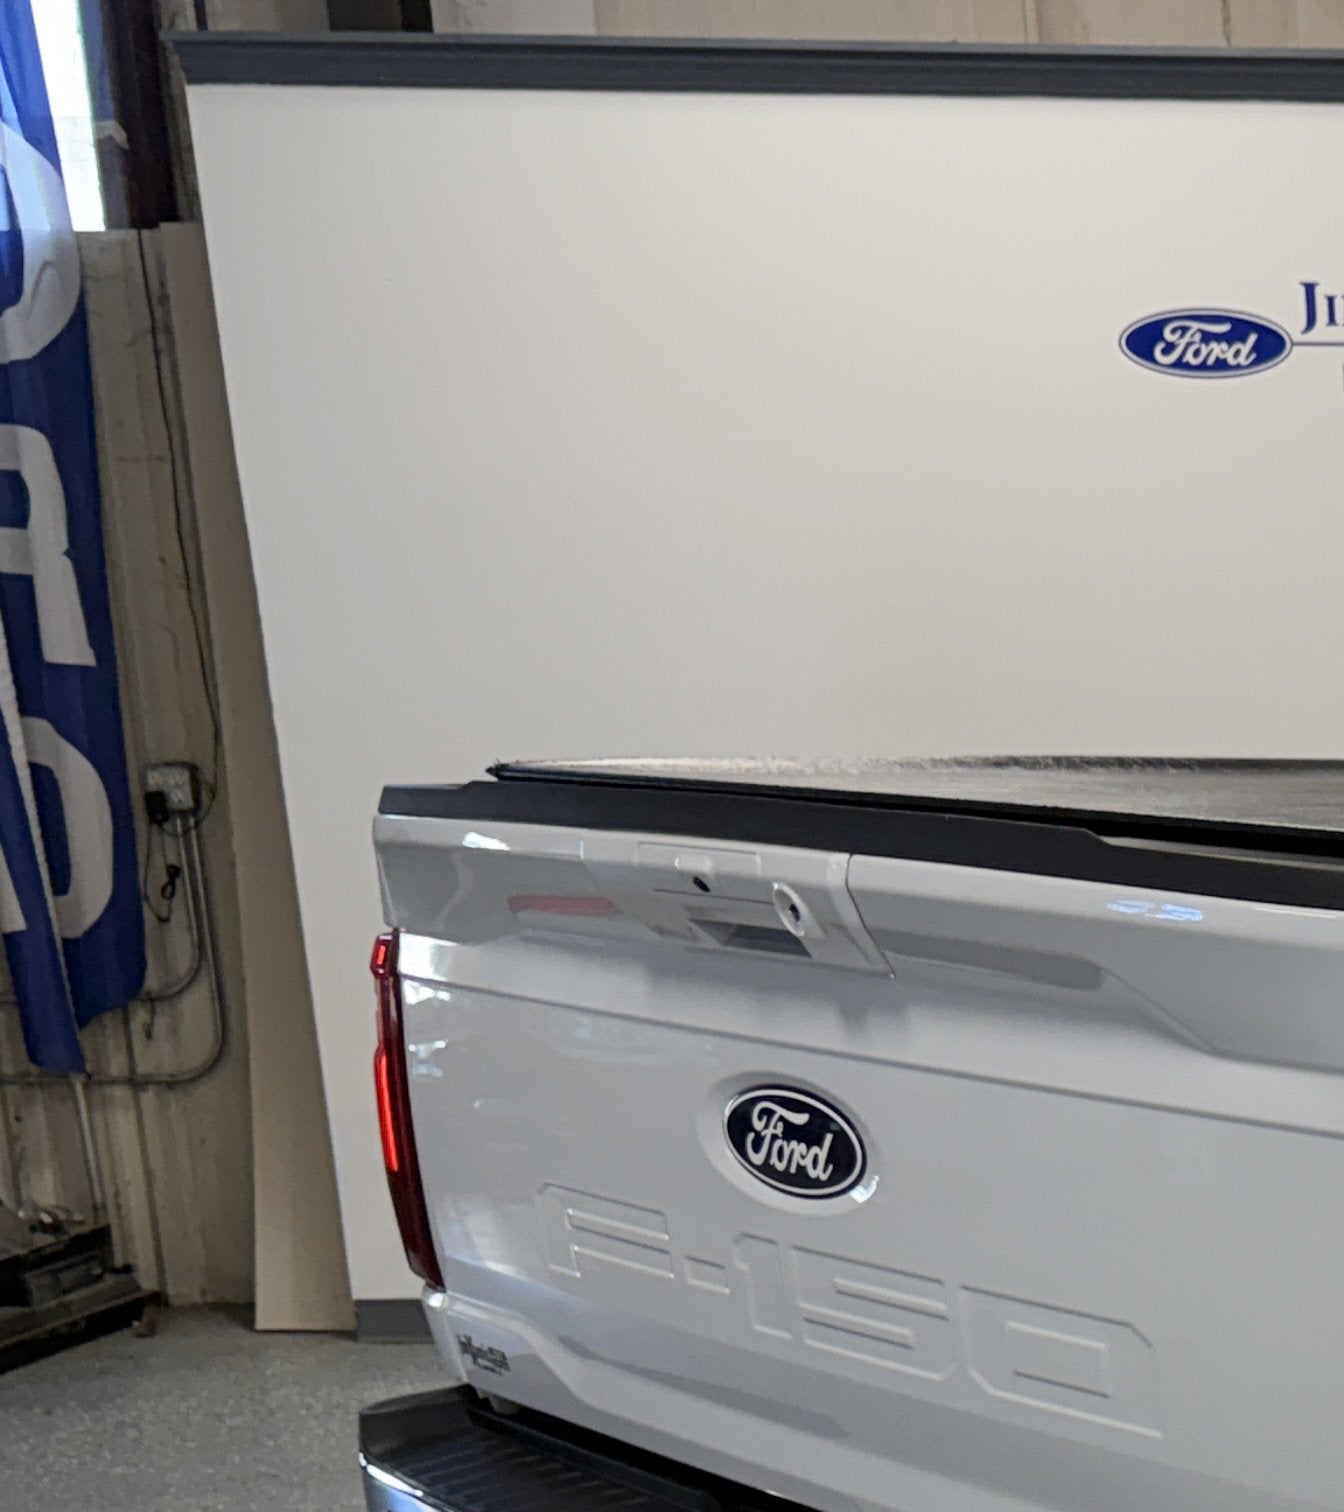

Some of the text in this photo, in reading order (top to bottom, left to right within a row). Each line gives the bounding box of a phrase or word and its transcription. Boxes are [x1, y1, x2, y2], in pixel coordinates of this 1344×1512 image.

[1153, 320, 1257, 368] Ford
[745, 1099, 834, 1183] Ford
[536, 1181, 1165, 1440] F-150
